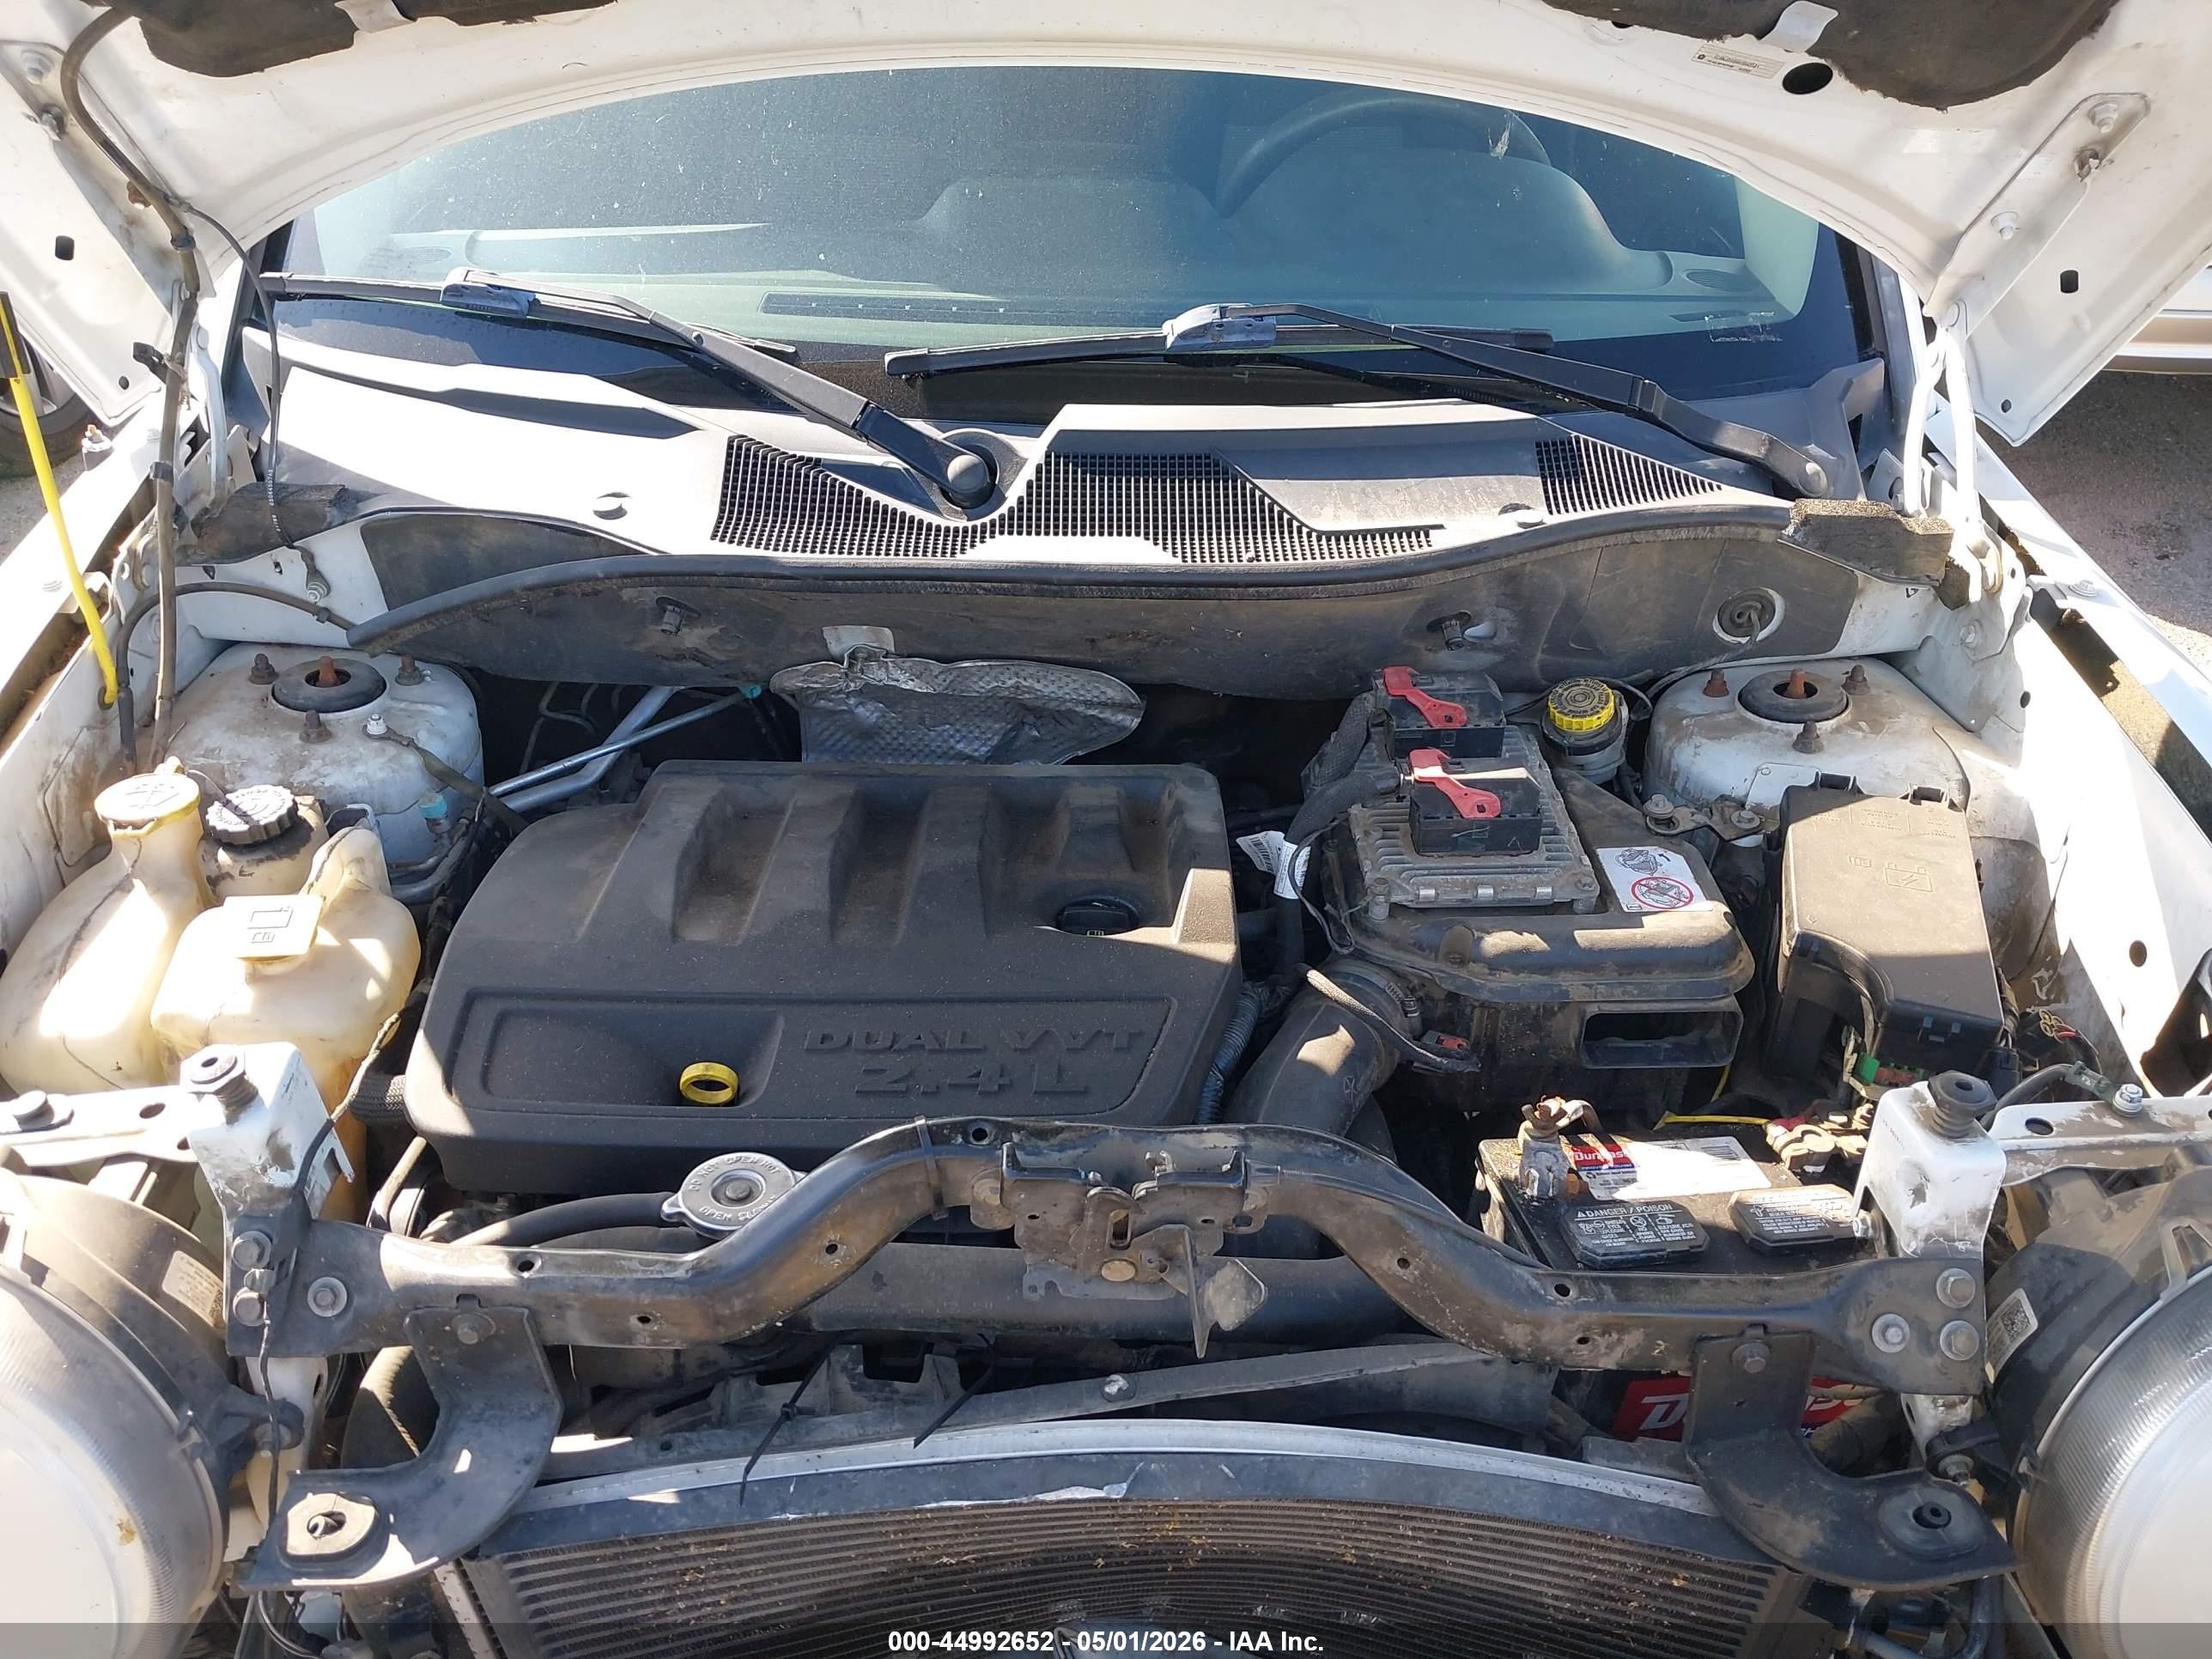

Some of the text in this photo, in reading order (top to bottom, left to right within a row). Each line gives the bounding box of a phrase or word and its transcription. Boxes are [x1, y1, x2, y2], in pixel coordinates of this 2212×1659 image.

[804, 1027, 1143, 1052] DUAL VVT
[689, 1178, 702, 1192] DO
[726, 1156, 758, 1165] OPEN
[761, 1159, 782, 1175] HOT
[699, 1206, 732, 1221] OPEN
[1584, 1207, 1627, 1218] DANGER
[1636, 1204, 1673, 1212] POISON
